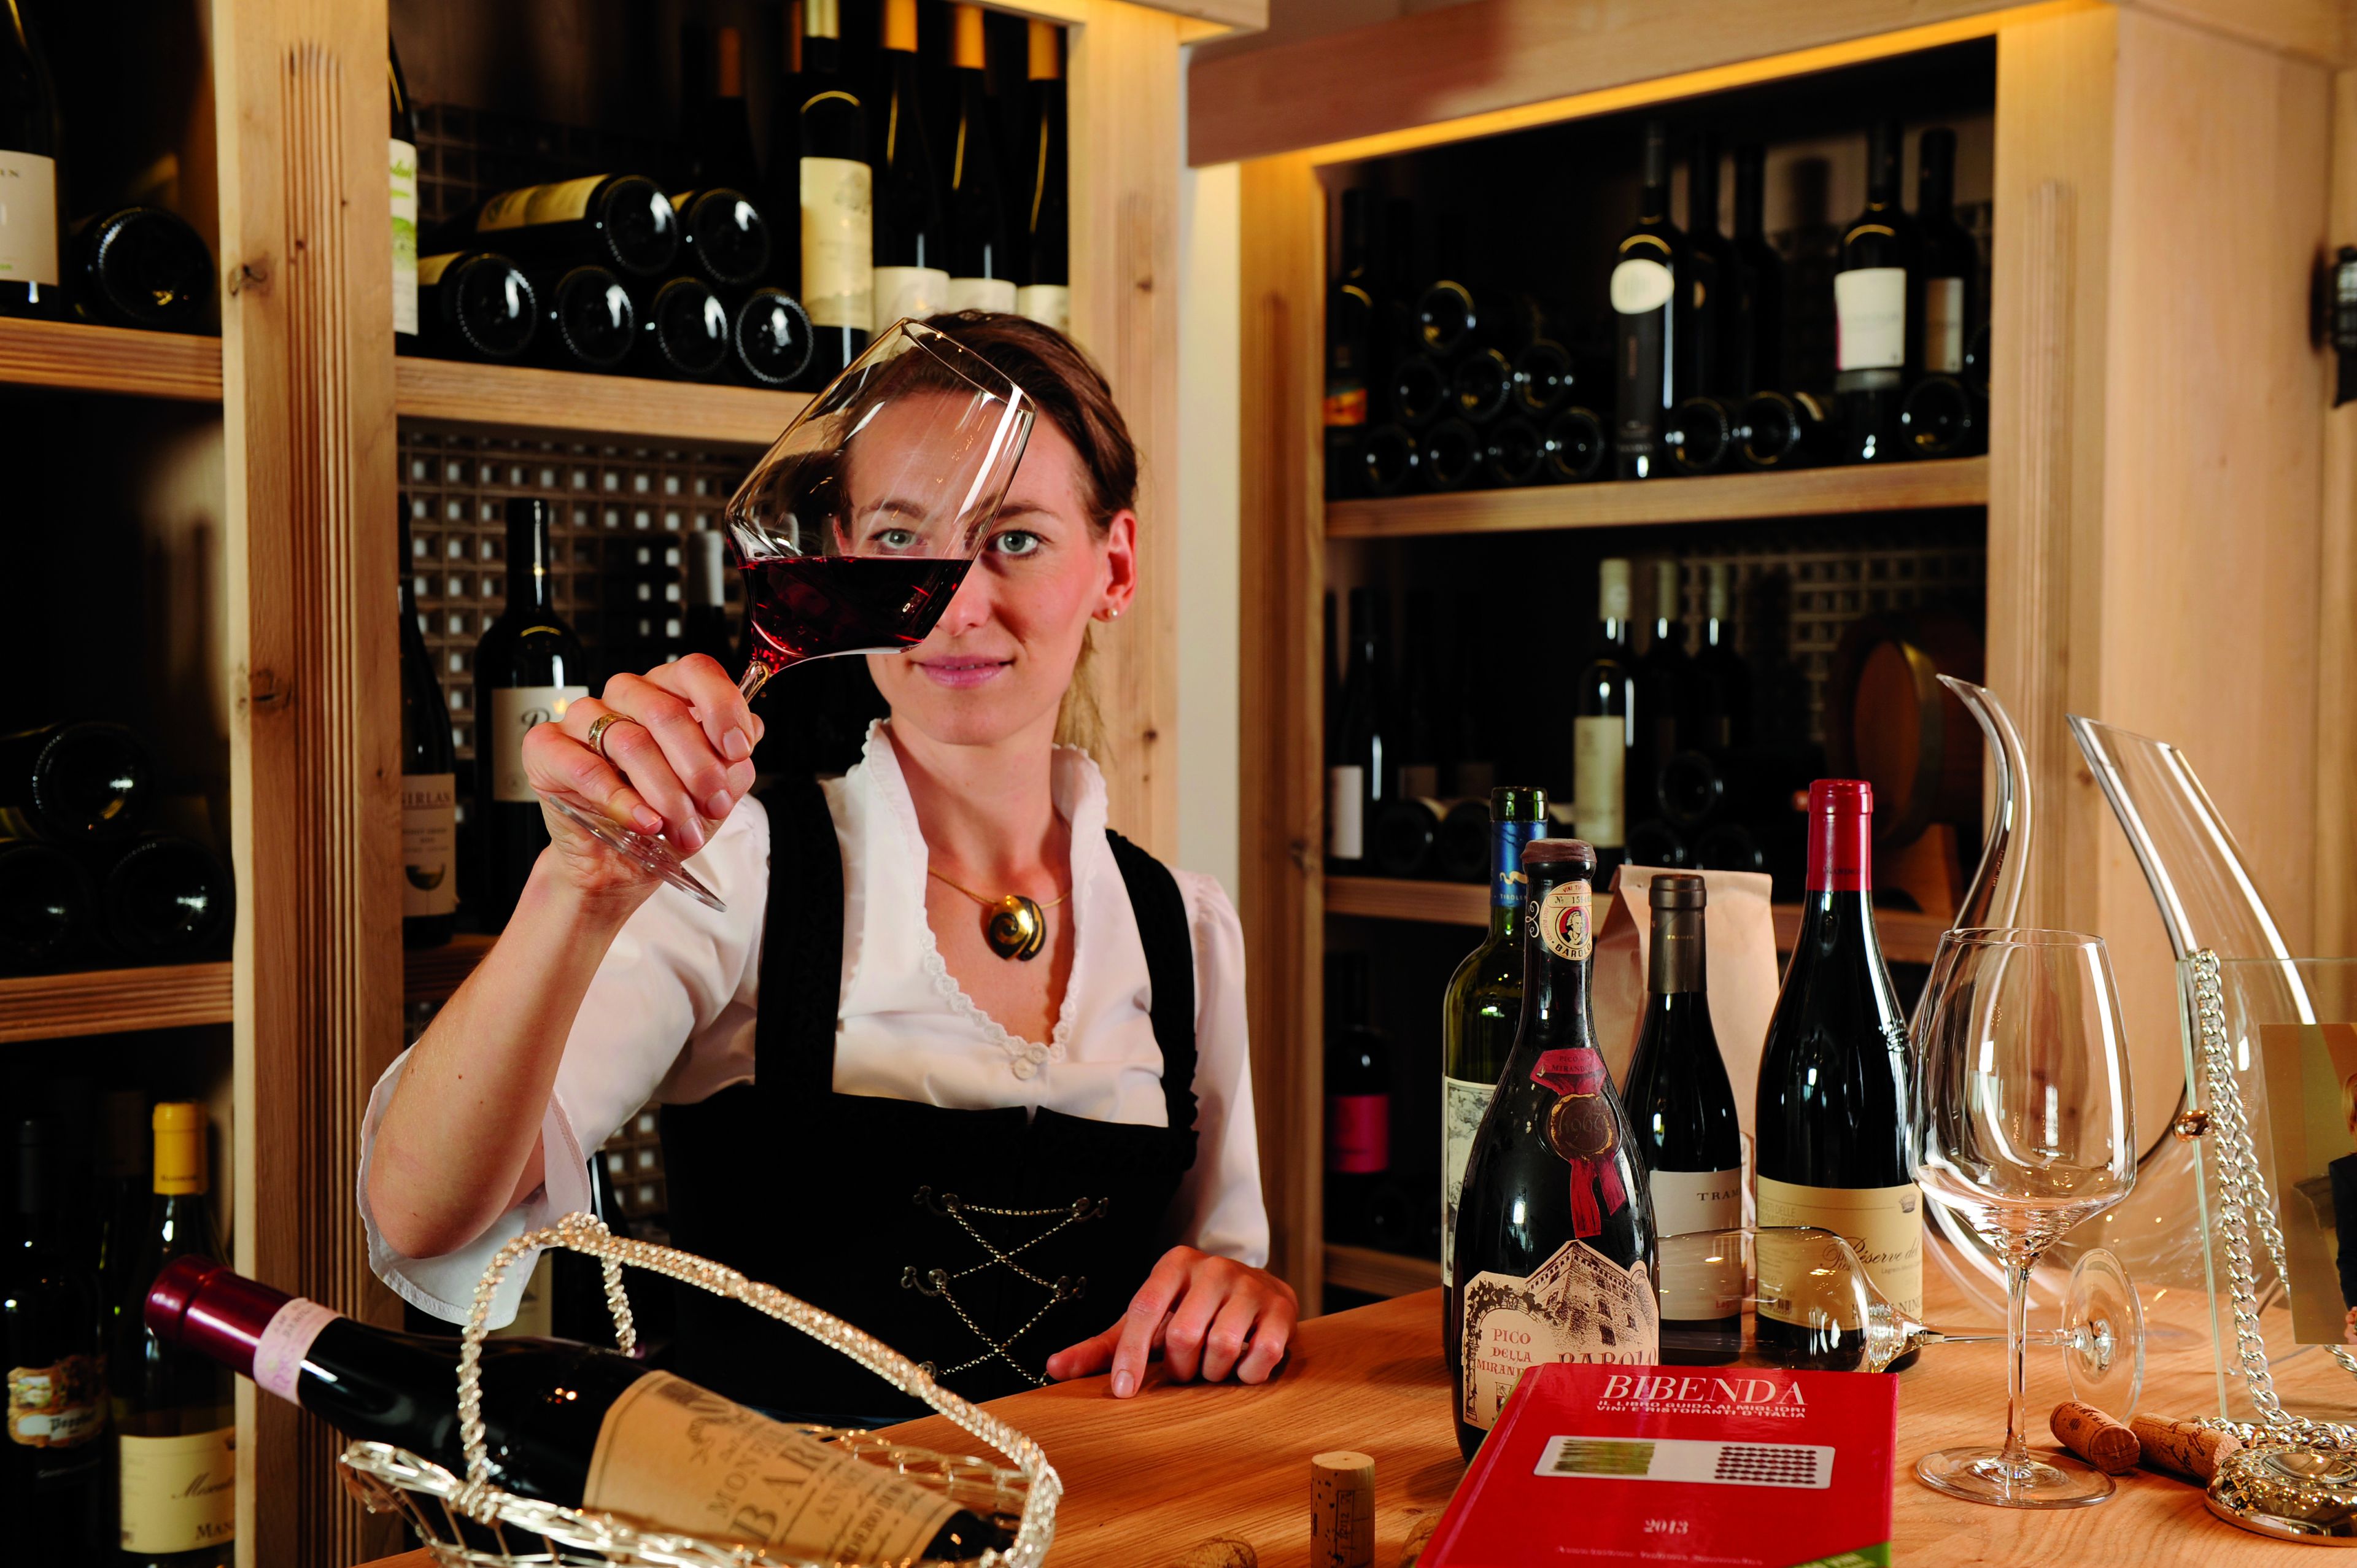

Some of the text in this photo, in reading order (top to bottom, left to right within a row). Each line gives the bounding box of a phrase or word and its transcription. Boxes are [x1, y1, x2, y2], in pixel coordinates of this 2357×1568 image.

[1555, 943, 1591, 958] BAROLO
[1492, 1327, 1531, 1345] PICO
[1490, 1346, 1533, 1364] DELLA
[1598, 1374, 1808, 1405] BIBENDA
[1648, 1407, 1737, 1416] RISTORANTI
[1667, 1402, 1712, 1410] GUIDA
[1735, 1404, 1806, 1413] MIGLIORI
[1643, 1518, 1689, 1534] 2013
